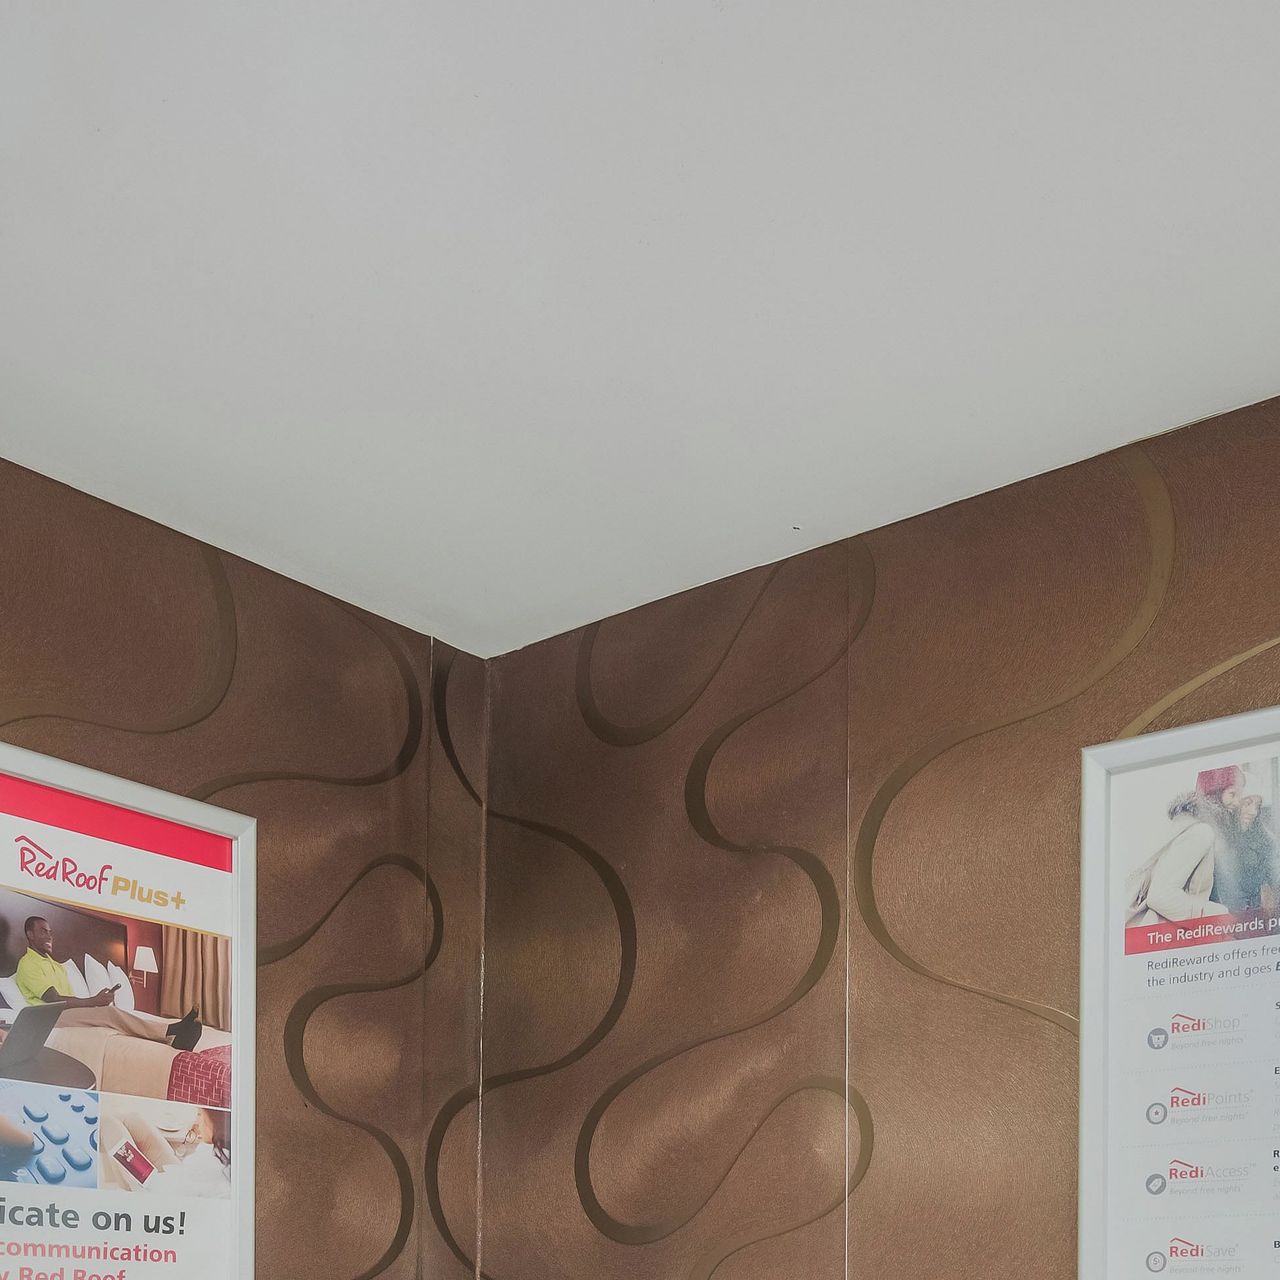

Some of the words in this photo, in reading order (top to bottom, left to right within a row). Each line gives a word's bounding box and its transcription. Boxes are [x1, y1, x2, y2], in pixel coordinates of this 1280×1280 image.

[111, 875, 186, 911] Plus+
[1147, 932, 1172, 945] The
[1177, 917, 1264, 941] RediRewards
[1147, 953, 1221, 971] RediRewards
[1223, 948, 1258, 961] offers
[1169, 971, 1214, 989] industry
[92, 1211, 132, 1232] on
[143, 1211, 186, 1235] us!
